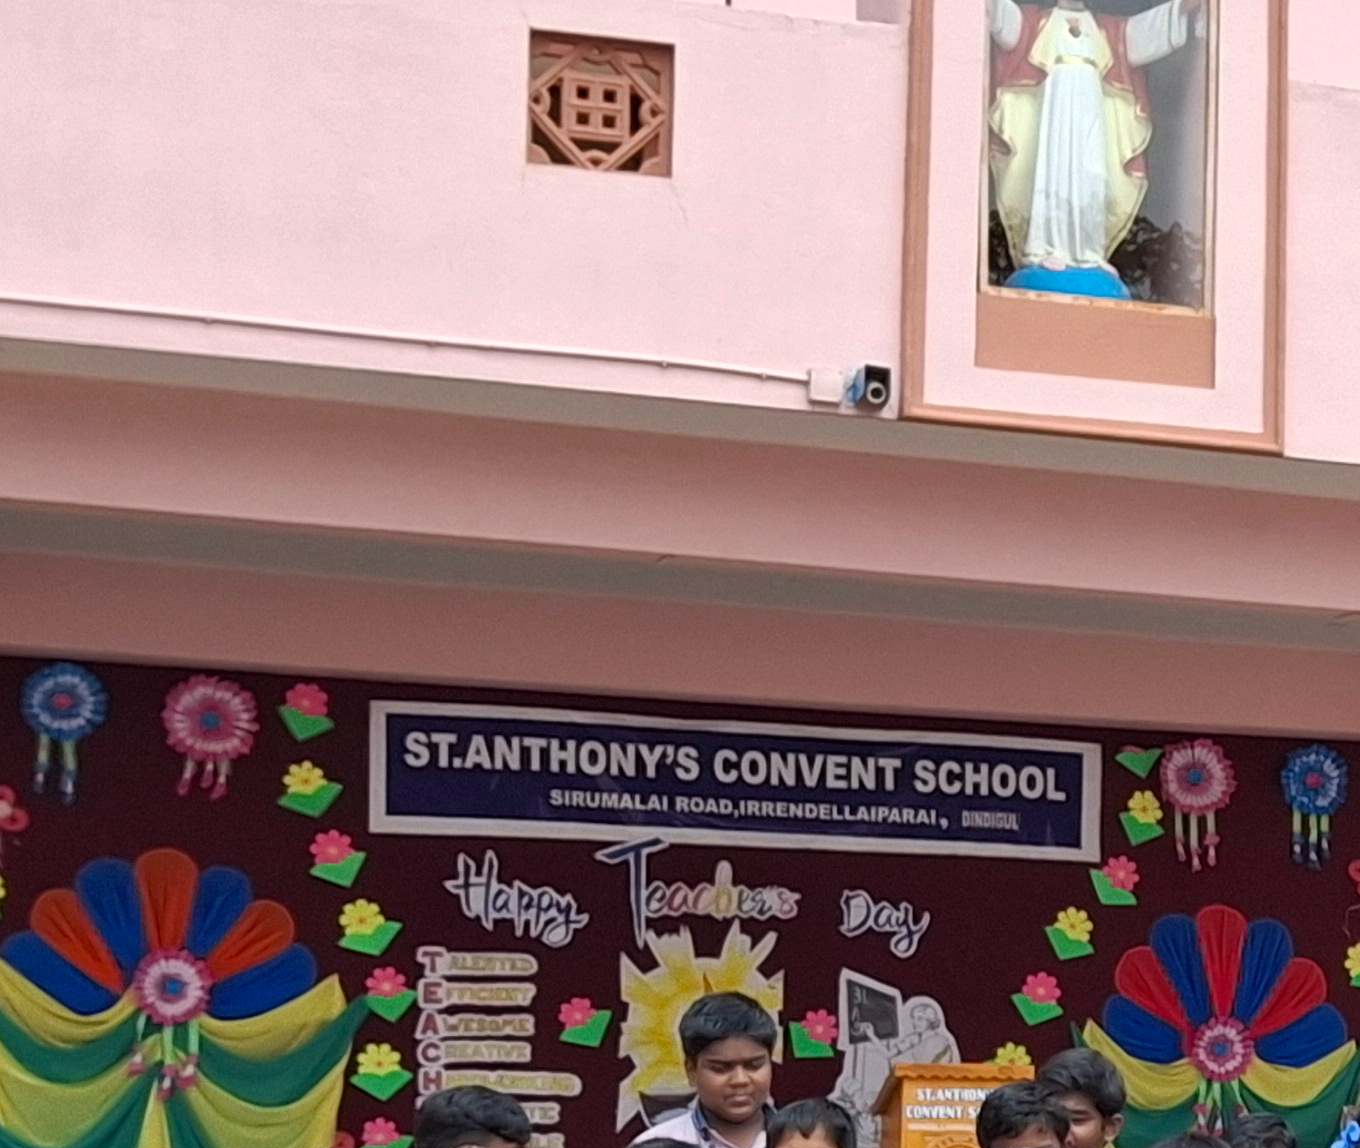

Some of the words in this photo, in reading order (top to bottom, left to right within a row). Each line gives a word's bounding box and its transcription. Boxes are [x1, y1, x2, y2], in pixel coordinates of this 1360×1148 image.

[403, 731, 700, 781] ST.ANTHONY'S
[713, 748, 902, 792] CONVENT
[913, 759, 1067, 802] SCHOOL
[549, 788, 668, 812] SIRUMALAI
[961, 809, 1020, 831] DINDIGUL
[447, 851, 586, 946] Happy
[841, 890, 927, 957] Day
[905, 1104, 961, 1119] CONVENT
